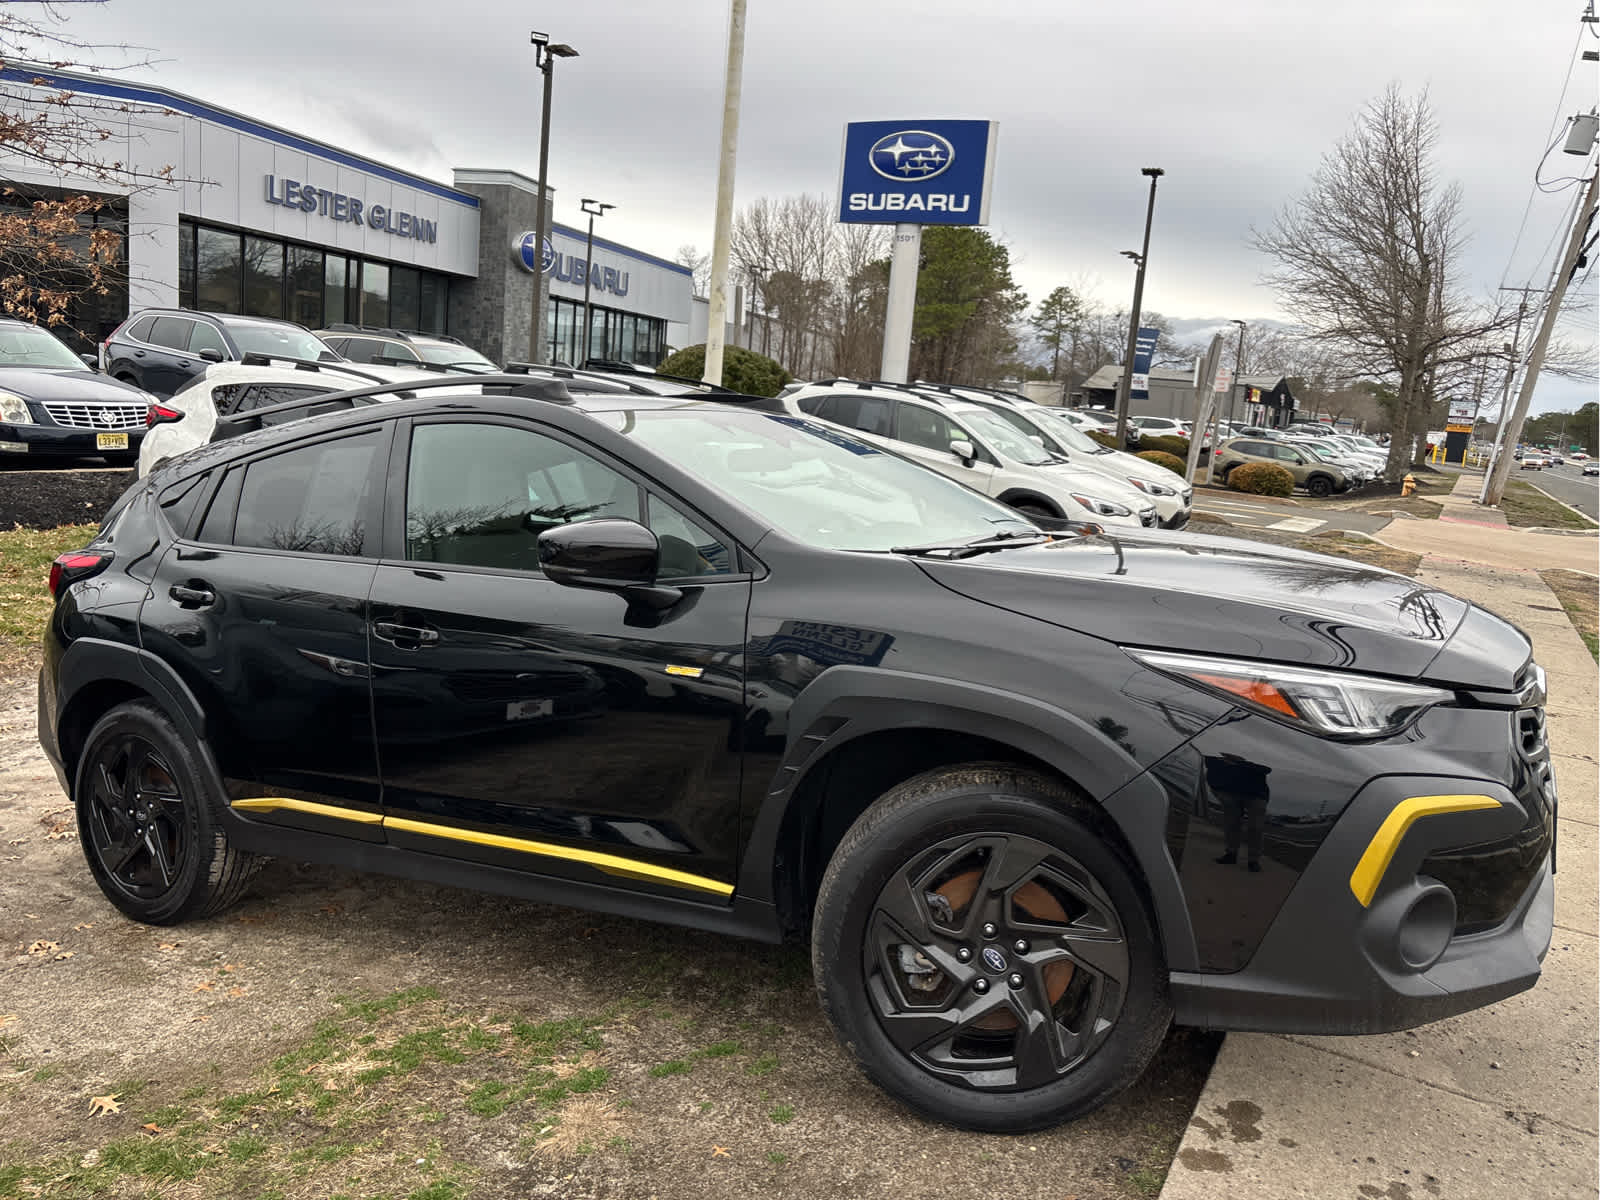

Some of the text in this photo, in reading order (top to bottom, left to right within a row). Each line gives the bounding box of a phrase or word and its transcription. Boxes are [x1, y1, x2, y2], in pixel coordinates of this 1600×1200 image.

[264, 174, 438, 245] LESTER GLENN
[849, 193, 970, 213] SUBARU
